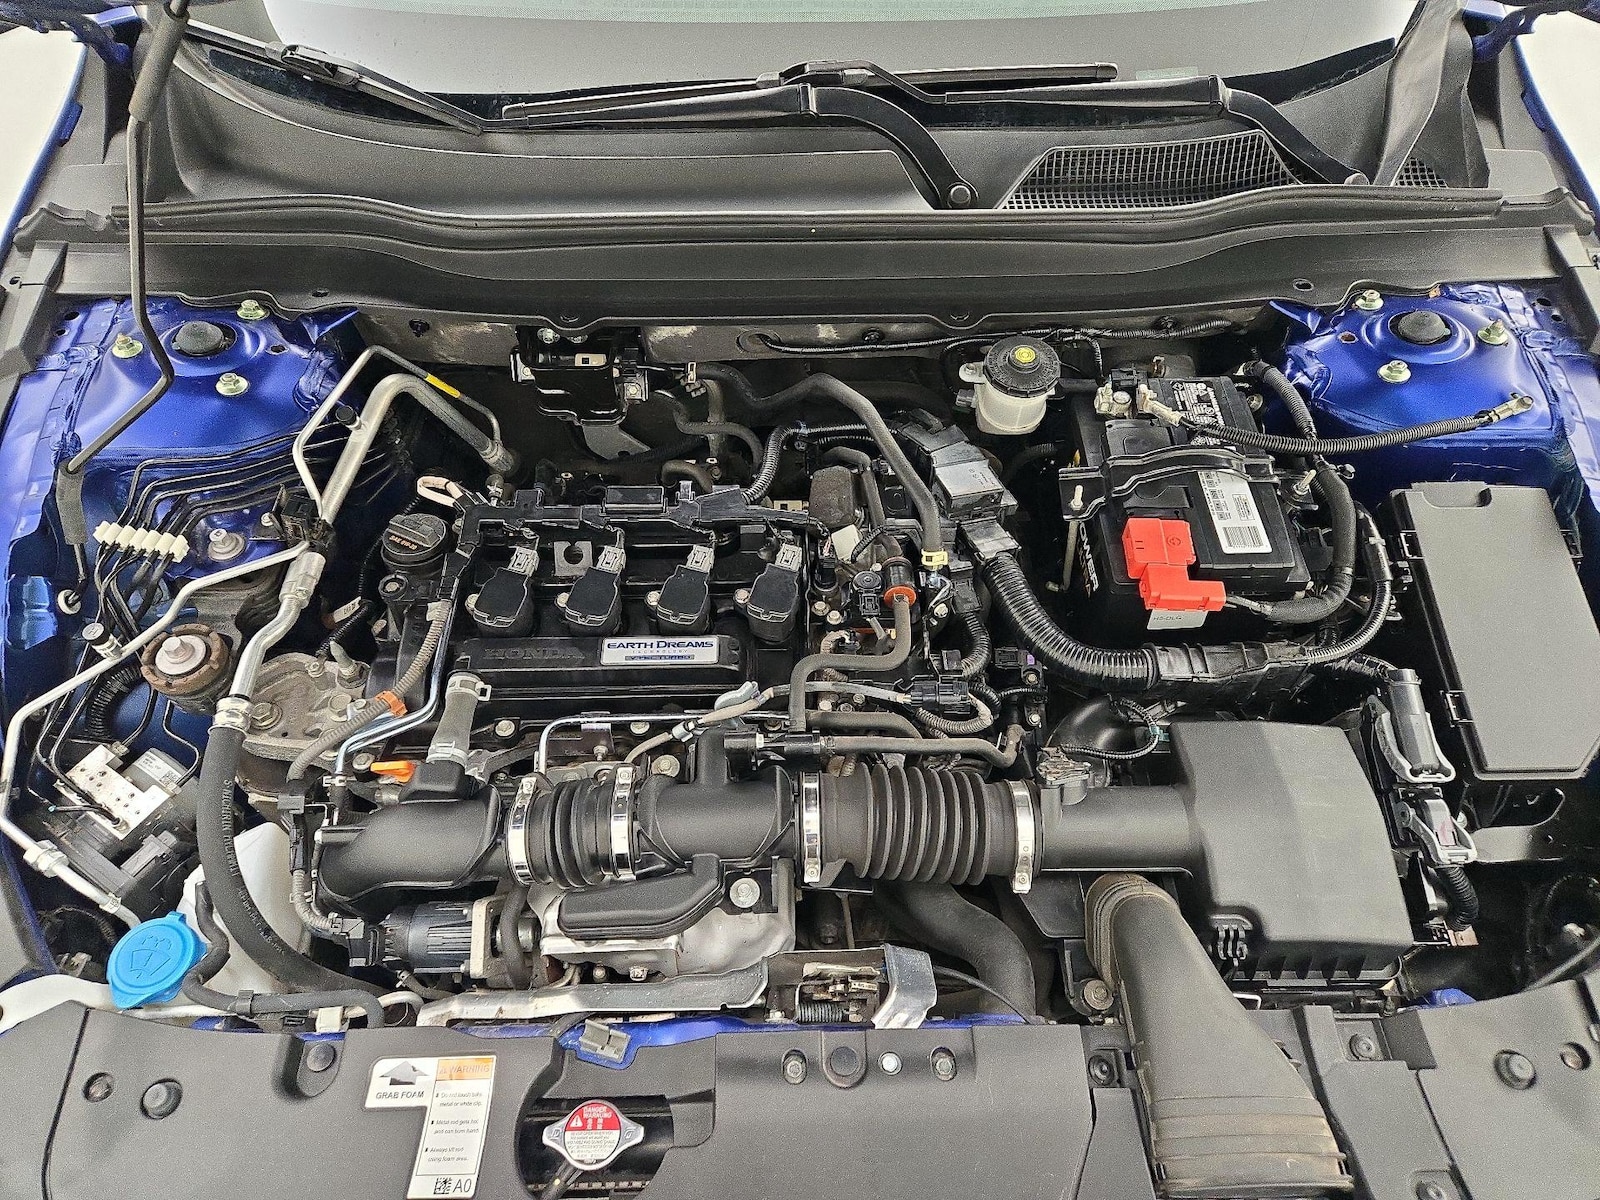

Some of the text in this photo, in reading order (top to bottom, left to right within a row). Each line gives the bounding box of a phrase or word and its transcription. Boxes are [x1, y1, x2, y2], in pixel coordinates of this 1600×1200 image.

[656, 640, 714, 649] DREAMS
[483, 647, 585, 660] HONDA
[451, 1063, 490, 1073] WARNING
[375, 1090, 425, 1099] GRAB FOAM
[453, 1178, 472, 1193] A0
